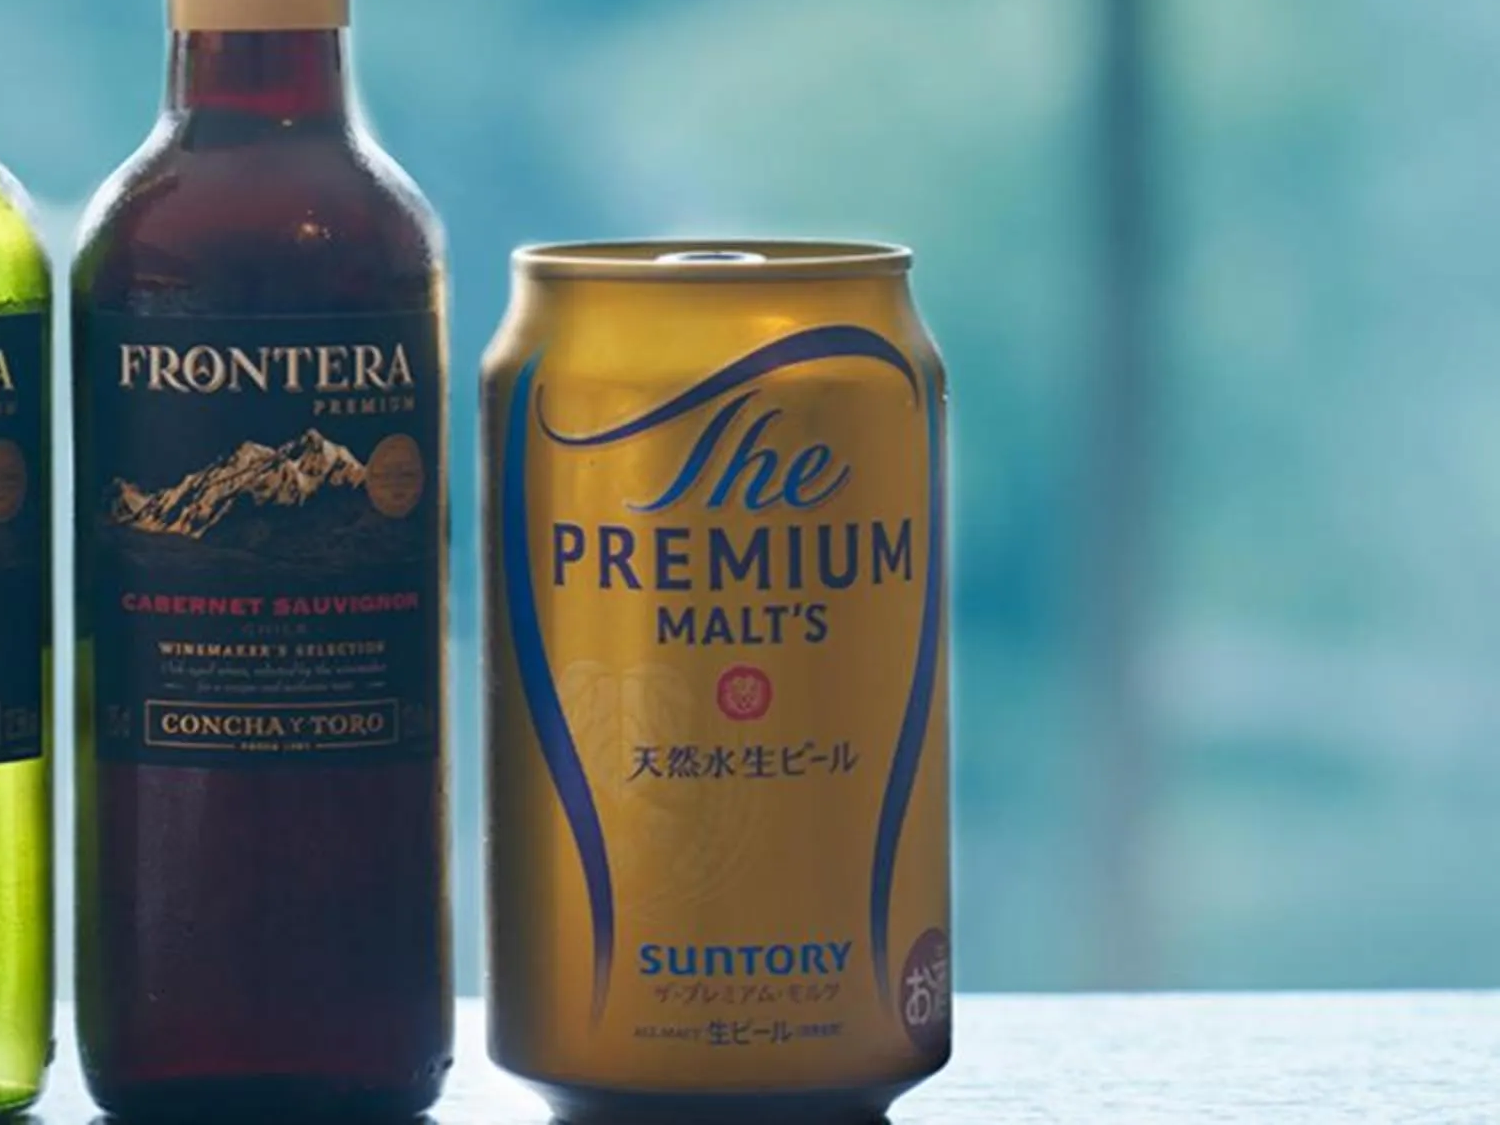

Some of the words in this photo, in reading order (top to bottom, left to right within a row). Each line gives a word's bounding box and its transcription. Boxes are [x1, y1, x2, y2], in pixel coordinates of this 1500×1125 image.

[119, 342, 414, 393] FRONTERA
[312, 395, 415, 416] PREMIUM
[626, 389, 852, 512] The
[553, 518, 913, 592] PREMIUM
[121, 592, 263, 617] CABERNET
[271, 591, 419, 616] SAUVIGNON
[657, 602, 829, 646] MALT'S
[160, 712, 285, 736] CONCHA
[287, 716, 305, 735] Y
[306, 712, 385, 736] TORO
[626, 741, 860, 782] 天然水生ビール
